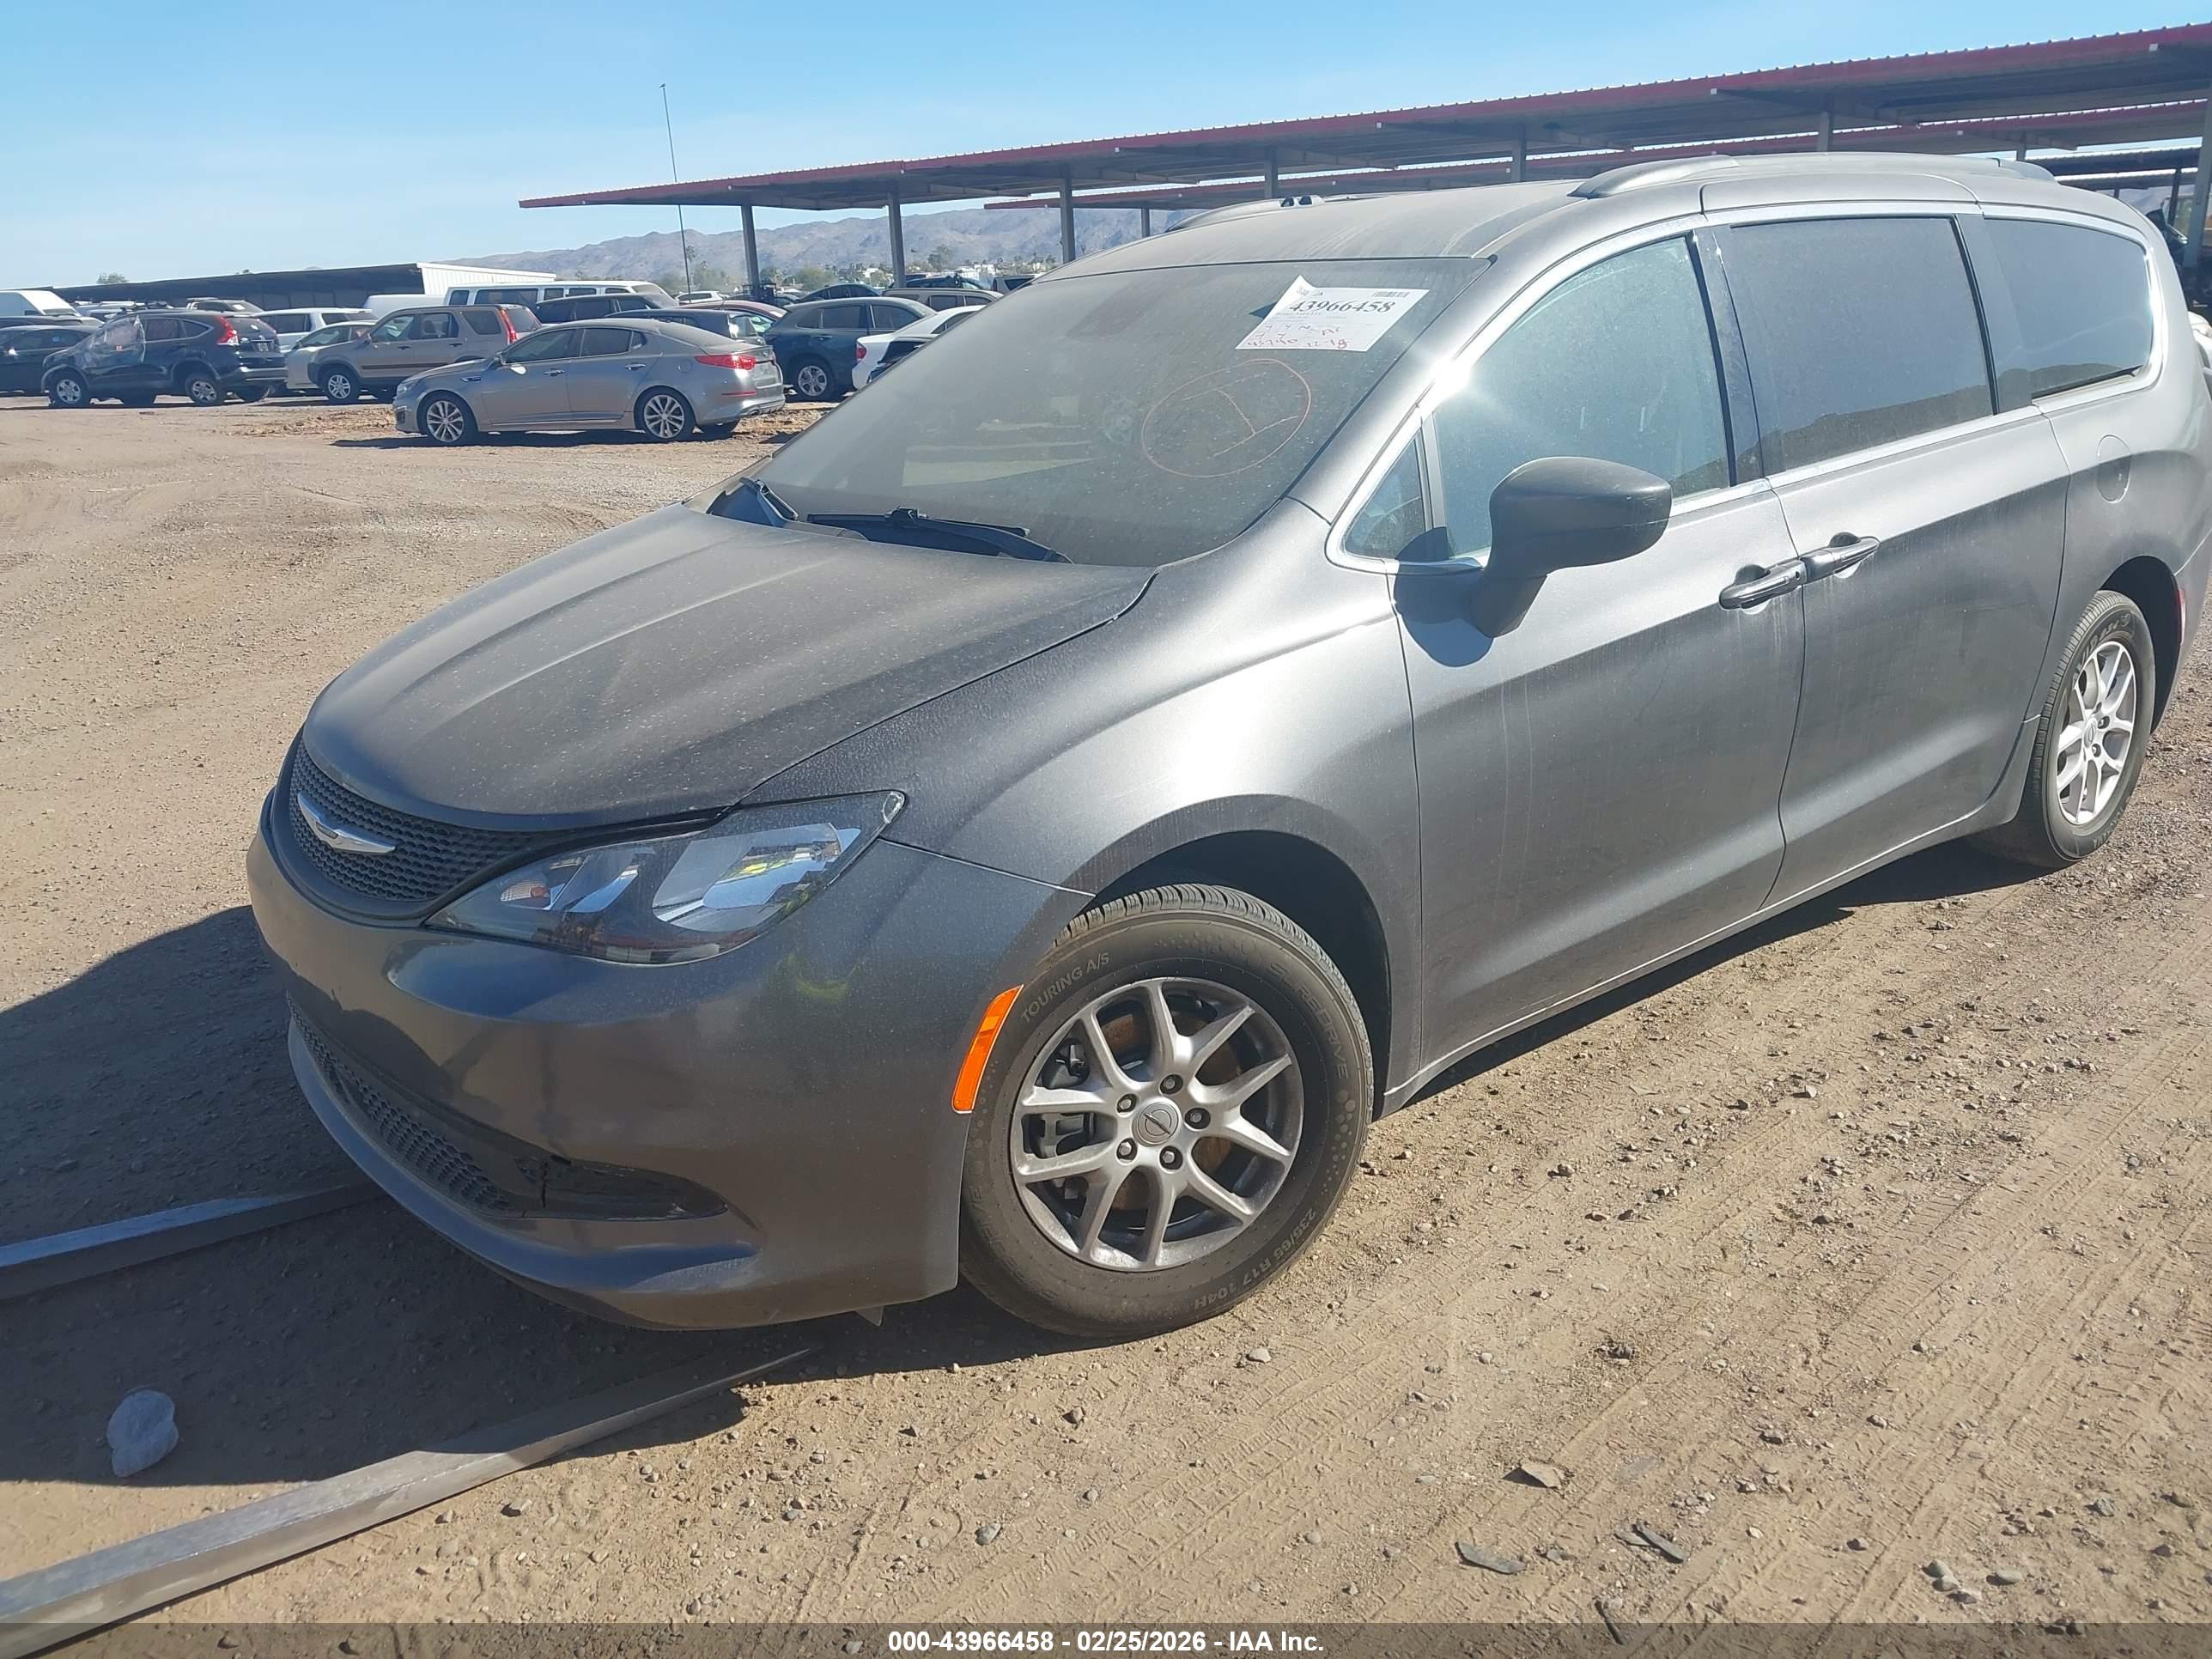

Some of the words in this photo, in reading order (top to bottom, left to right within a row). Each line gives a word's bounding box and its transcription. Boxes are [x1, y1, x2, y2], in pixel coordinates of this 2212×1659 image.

[1289, 300, 1396, 313] 43966458
[1020, 966, 1084, 1024] TOURING
[1085, 952, 1110, 974] A/S
[1273, 1208, 1317, 1261] 235/65
[1243, 1257, 1272, 1286] R17
[1194, 1283, 1238, 1310] 104H
